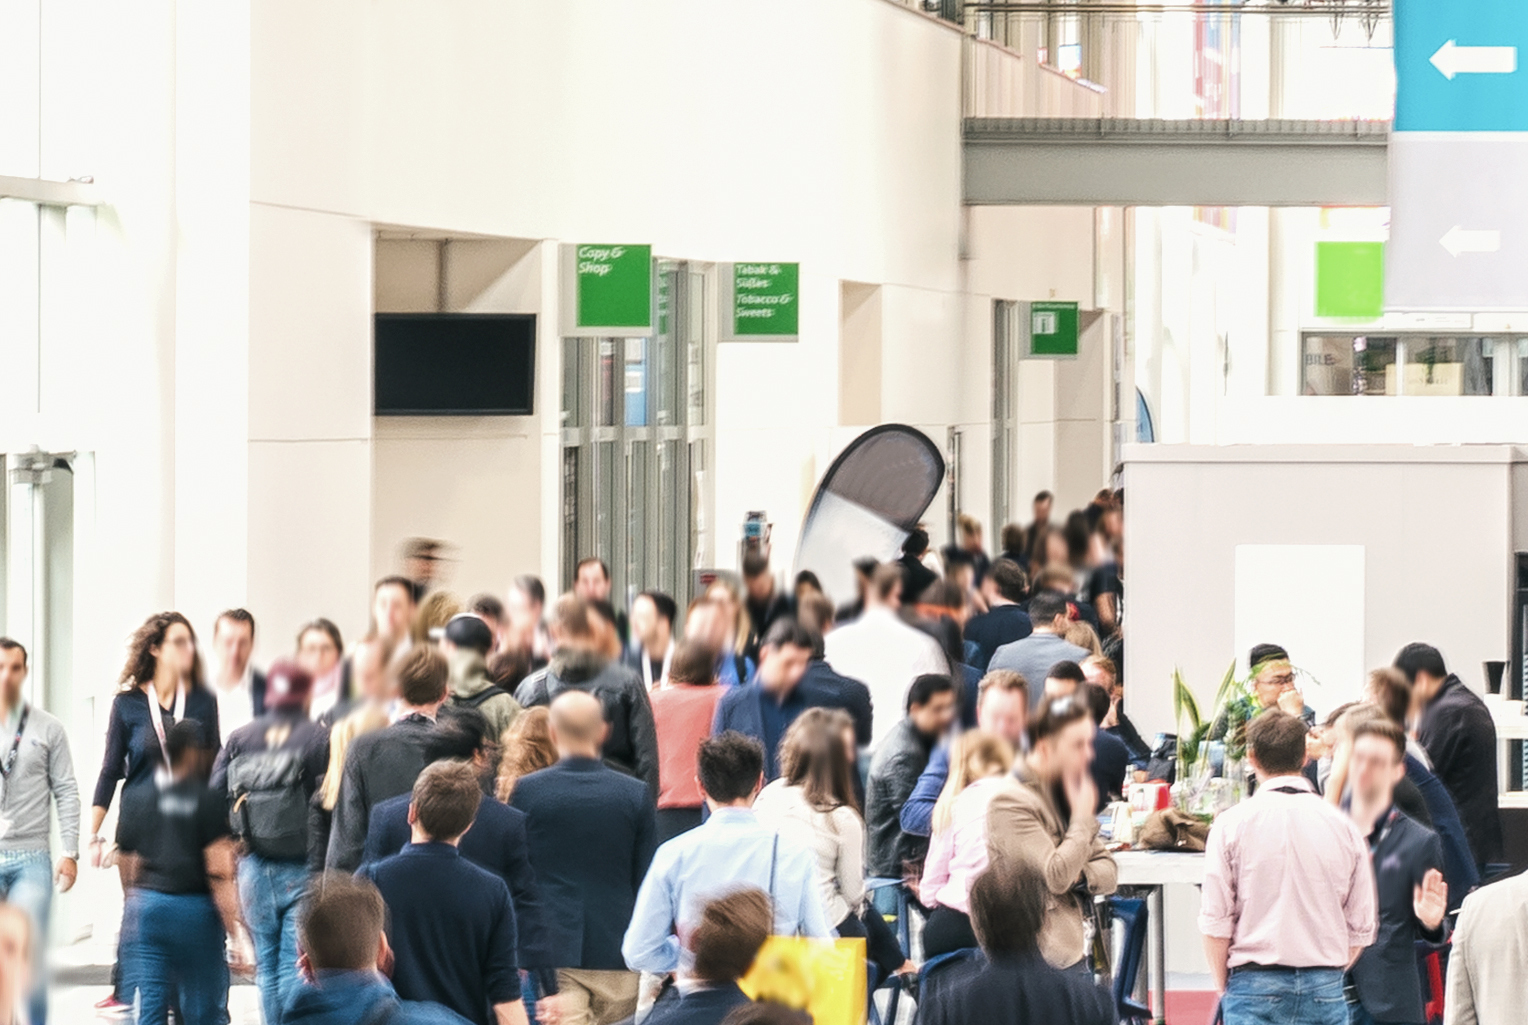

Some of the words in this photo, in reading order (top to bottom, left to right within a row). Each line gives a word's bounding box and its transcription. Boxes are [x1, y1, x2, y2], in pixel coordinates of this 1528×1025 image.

[578, 246, 610, 261] Copy
[611, 246, 625, 258] &
[578, 261, 612, 276] Shop
[736, 264, 767, 275] Tabak
[768, 264, 781, 275] &
[736, 294, 780, 304] Tobacco
[779, 293, 794, 304] &
[736, 307, 774, 318] Sweets
